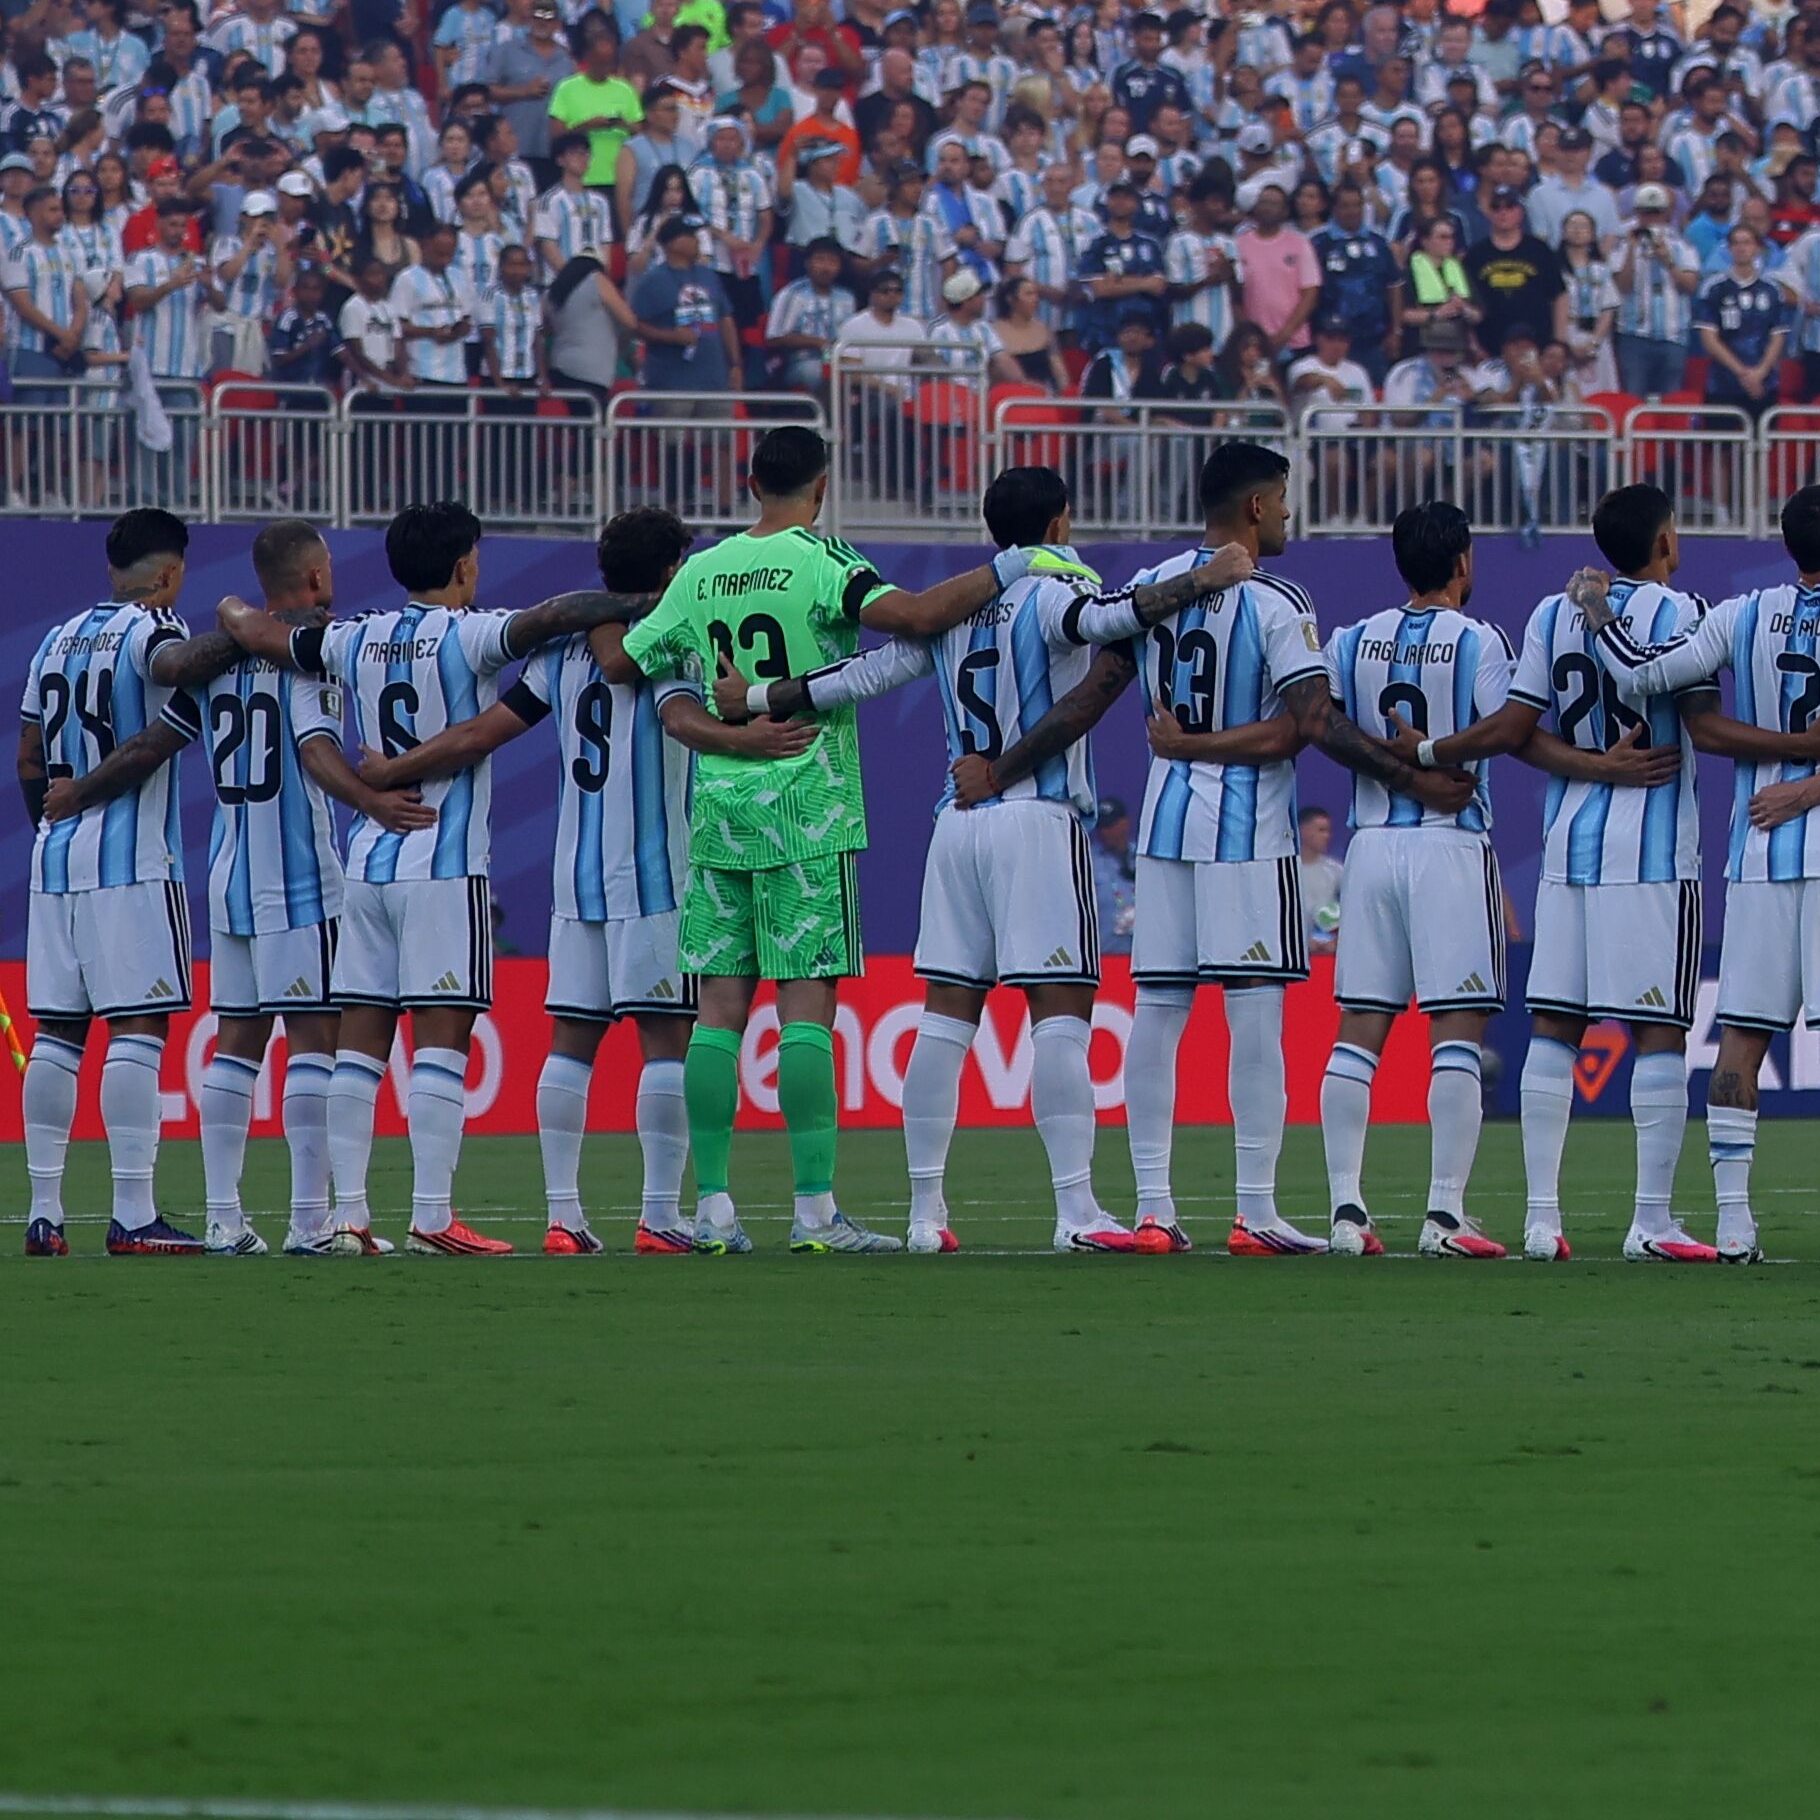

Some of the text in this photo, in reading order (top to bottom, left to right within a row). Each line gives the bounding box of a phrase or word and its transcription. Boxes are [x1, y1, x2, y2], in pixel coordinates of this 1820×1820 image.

[697, 577, 708, 601] E.
[1769, 612, 1795, 636] DE
[957, 647, 1004, 760] 5
[1152, 623, 1219, 736] 13
[209, 692, 283, 805] 20
[572, 681, 614, 794] 9
